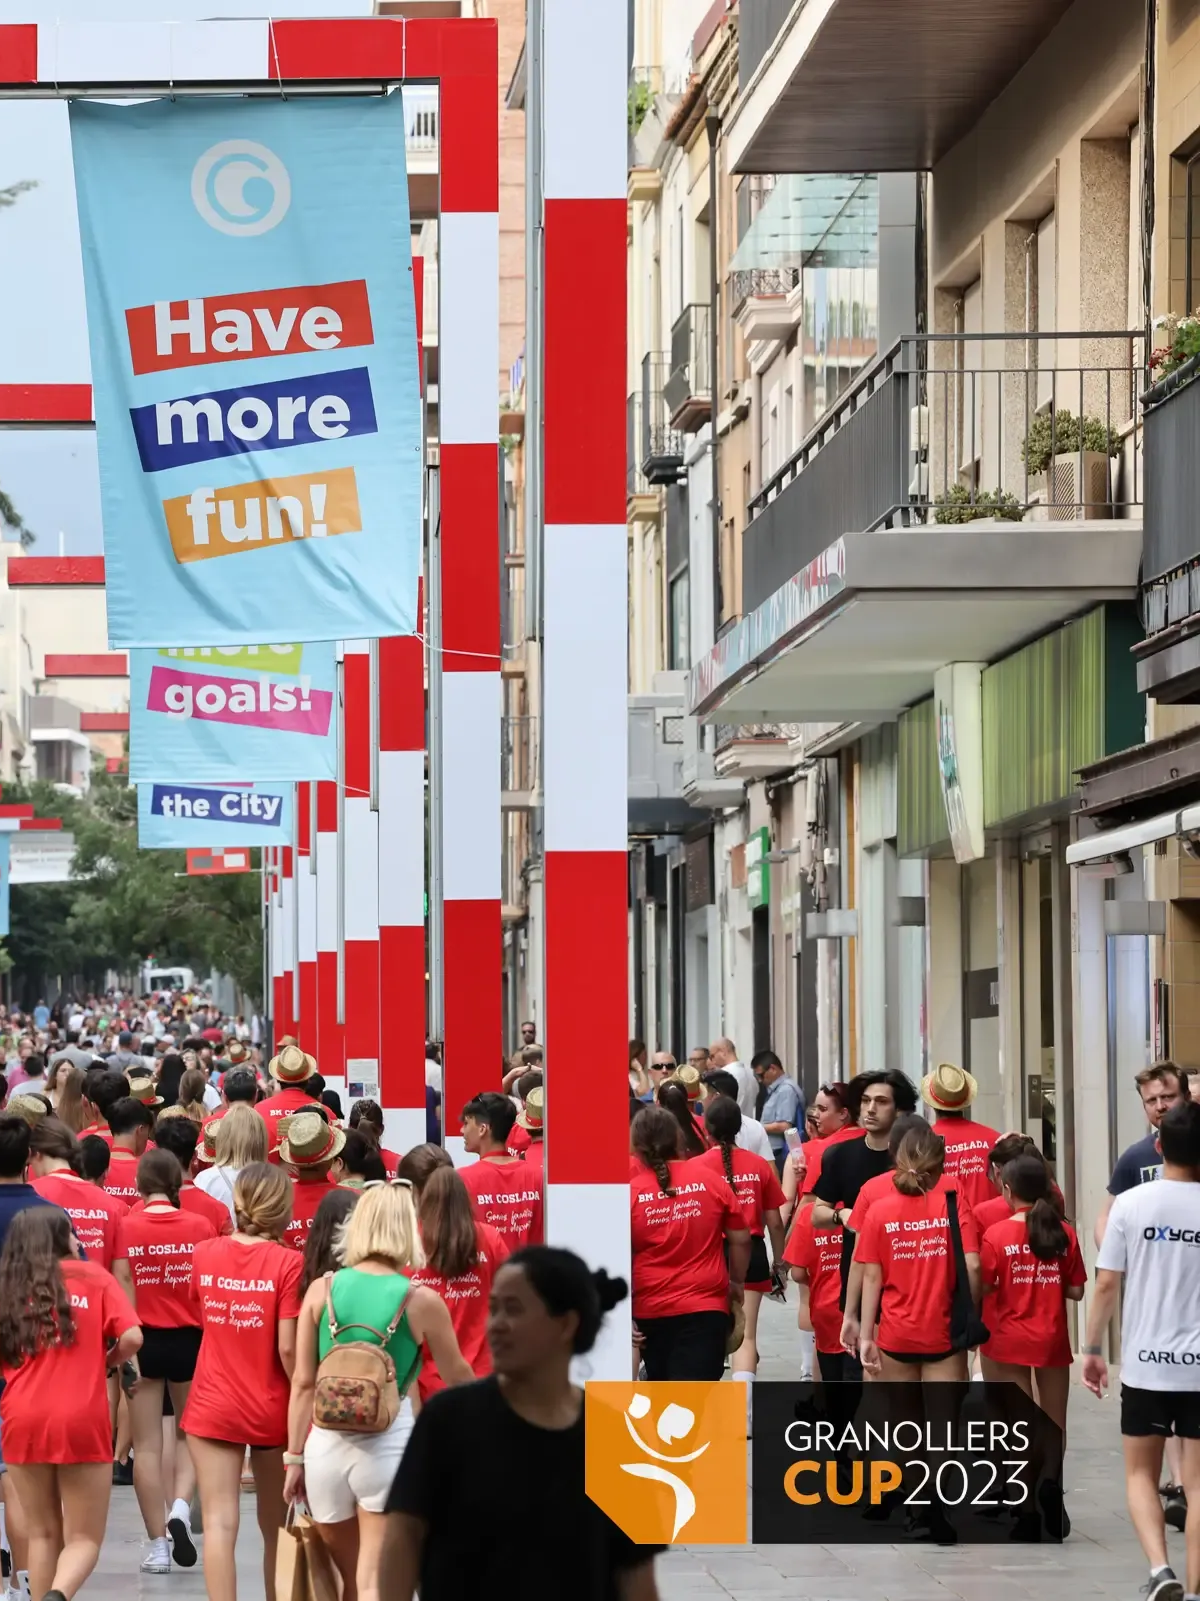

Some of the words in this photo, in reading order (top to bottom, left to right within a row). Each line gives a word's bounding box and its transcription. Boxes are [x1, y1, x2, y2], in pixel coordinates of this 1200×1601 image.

[154, 298, 343, 356] Have
[155, 392, 351, 446] more
[186, 483, 328, 545] fun!
[164, 674, 312, 721] goals!
[161, 793, 210, 817] the
[220, 793, 280, 820] City
[945, 1140, 989, 1154] COSLADA
[477, 1194, 494, 1205] BM
[496, 1190, 541, 1204] COSLADA
[638, 1193, 654, 1203] BM
[885, 1221, 900, 1234] BM
[814, 1236, 828, 1246] BM
[128, 1246, 145, 1257] BM
[148, 1243, 193, 1256] COSLAD
[1004, 1244, 1020, 1256] BM
[163, 1273, 192, 1290] deport
[217, 1276, 275, 1293] COSLADA
[1035, 1274, 1060, 1290] deport
